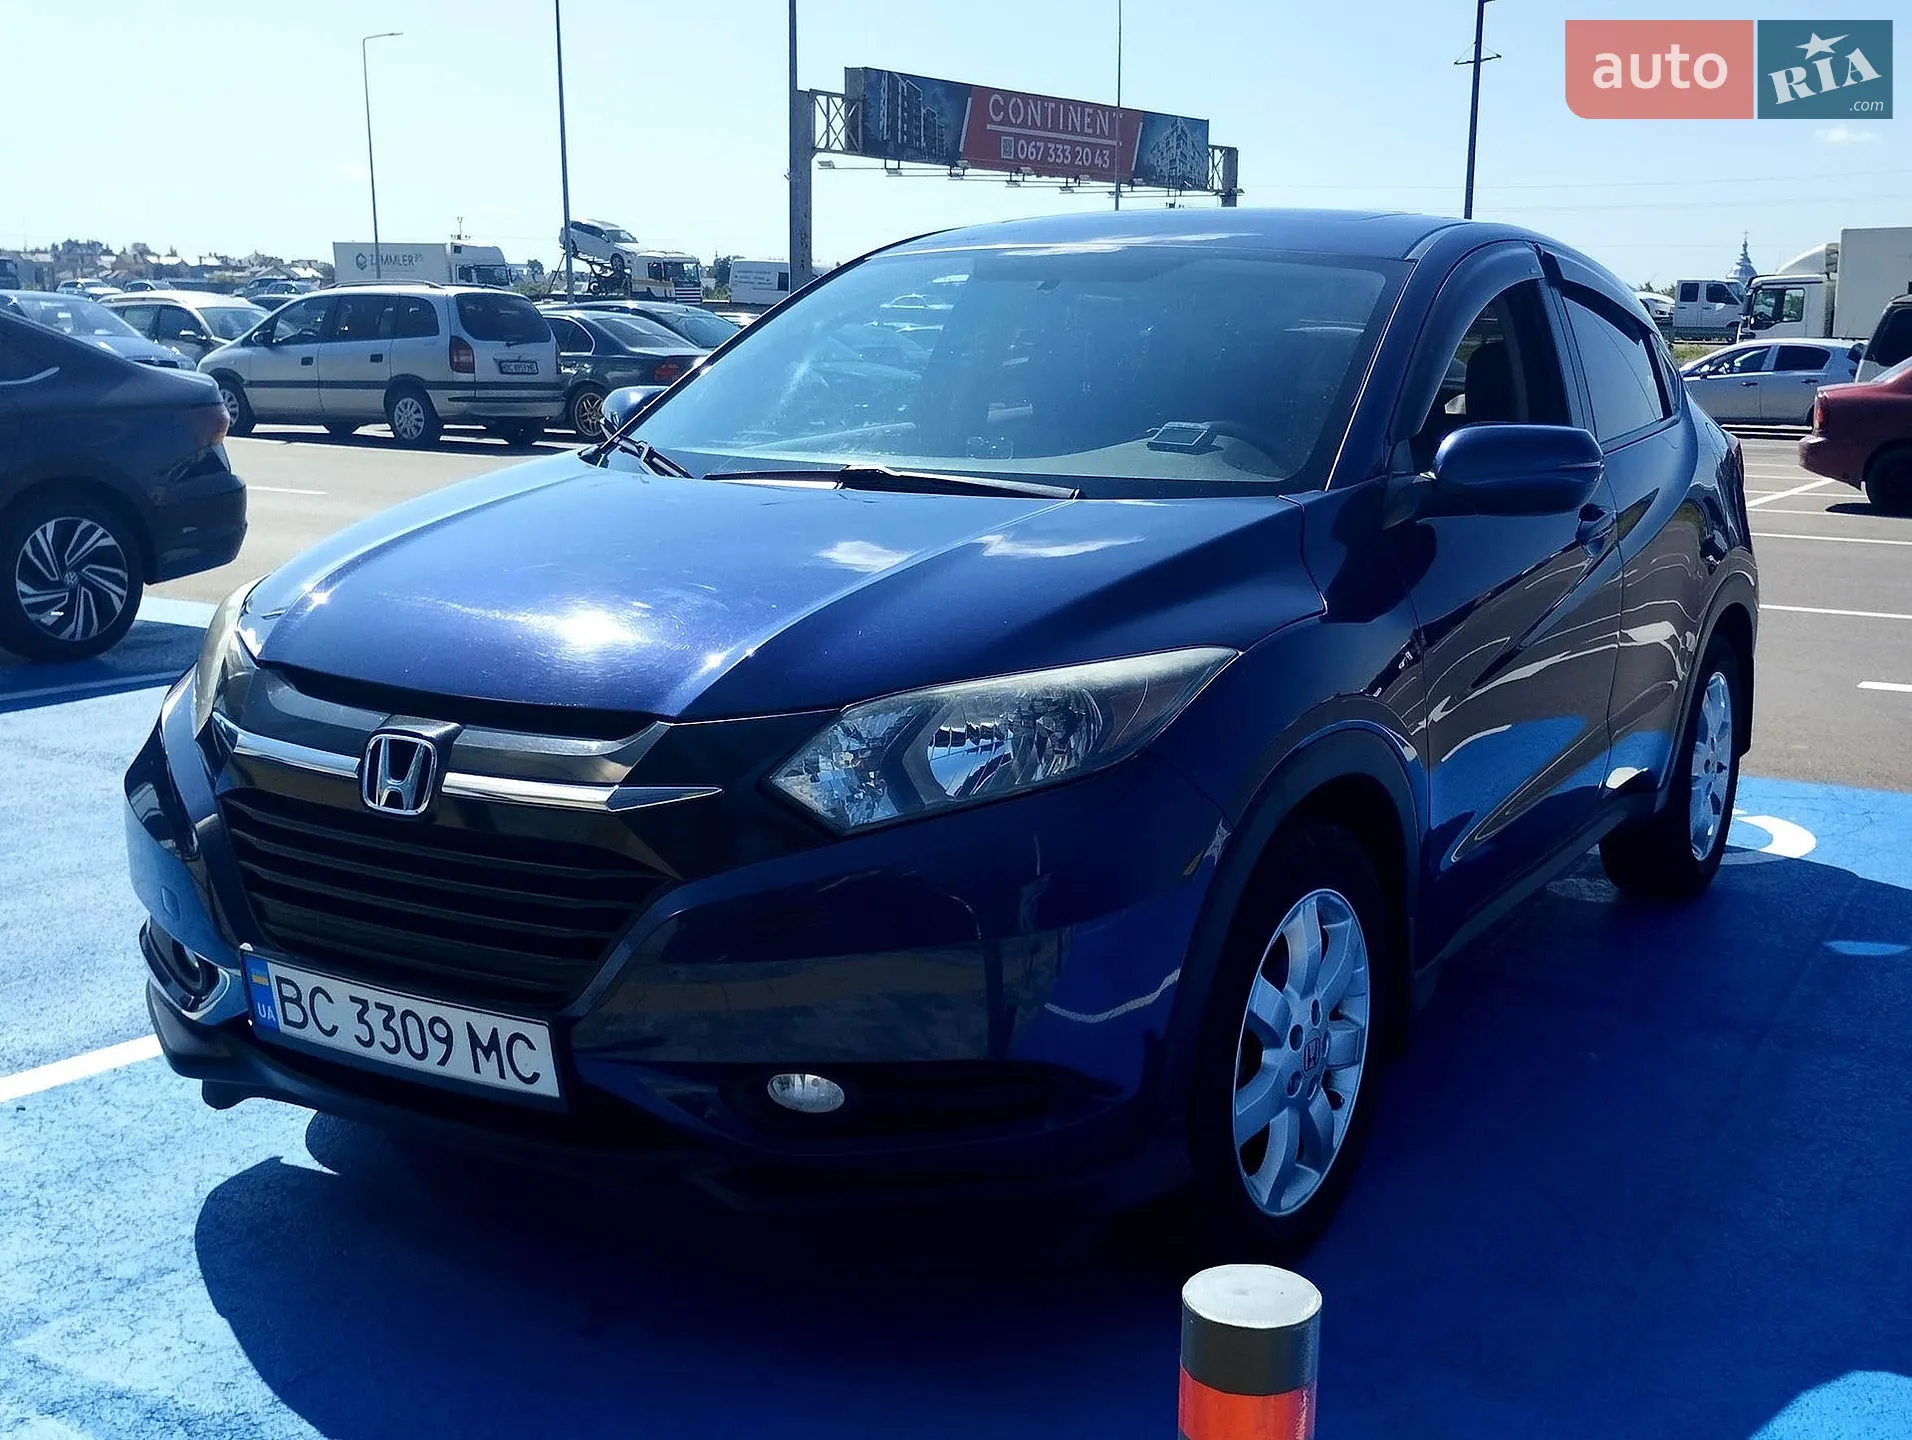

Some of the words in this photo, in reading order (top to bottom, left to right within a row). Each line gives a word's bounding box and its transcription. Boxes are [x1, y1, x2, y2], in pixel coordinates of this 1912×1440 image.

[1017, 139, 1045, 161] 067
[1047, 142, 1072, 165] 333
[1074, 146, 1092, 167] 20
[1094, 149, 1110, 169] 43
[369, 253, 415, 267] ZMMLER
[257, 1002, 276, 1022] UA
[274, 975, 339, 1037] BC
[349, 995, 454, 1067] 3309
[466, 1021, 541, 1086] MC
